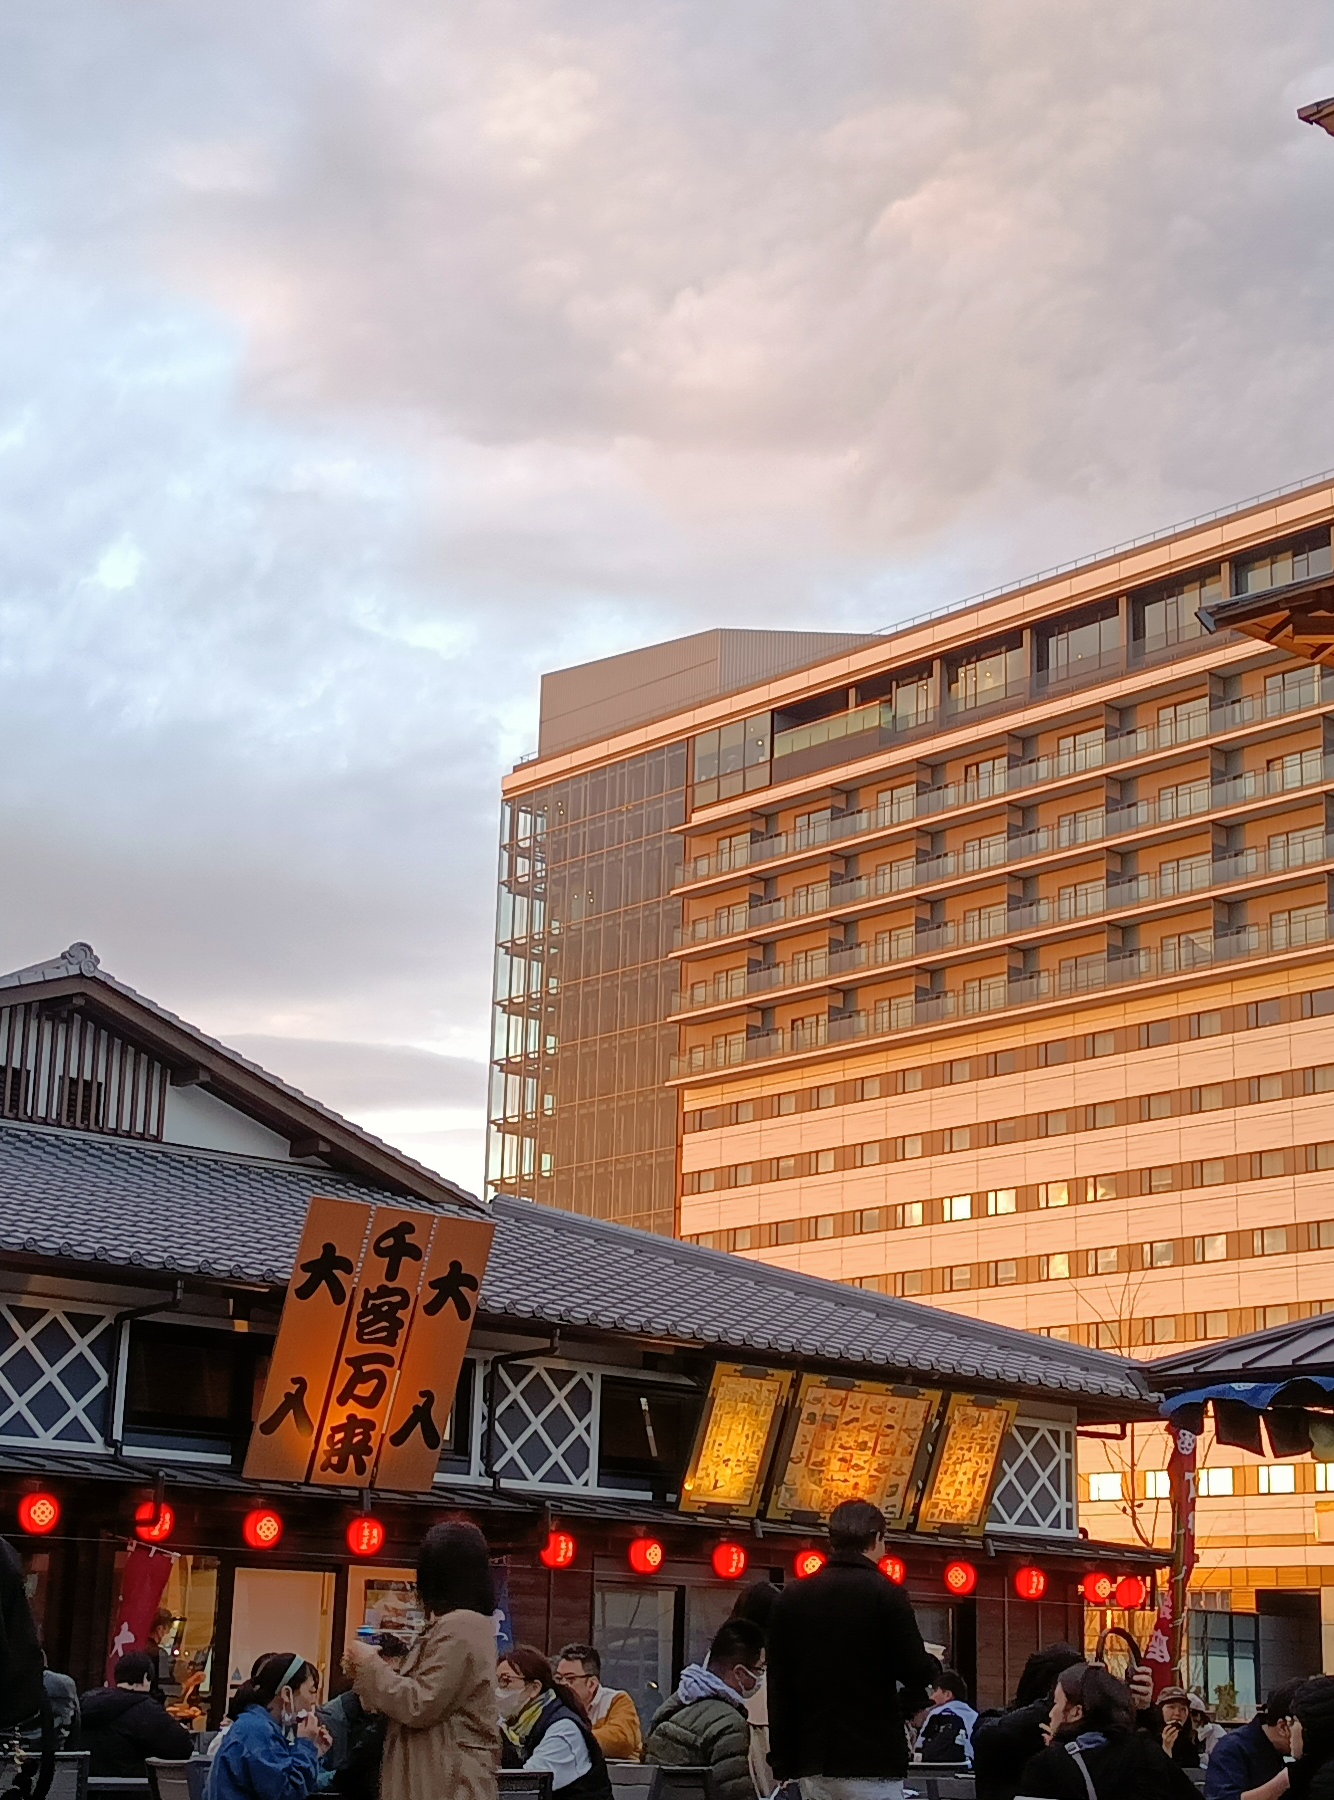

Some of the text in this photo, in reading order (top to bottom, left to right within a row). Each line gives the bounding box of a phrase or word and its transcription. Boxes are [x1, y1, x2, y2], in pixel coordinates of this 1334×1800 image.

[259, 1242, 355, 1439] 大入
[319, 1221, 423, 1477] 千客万来
[389, 1260, 479, 1451] 大入
